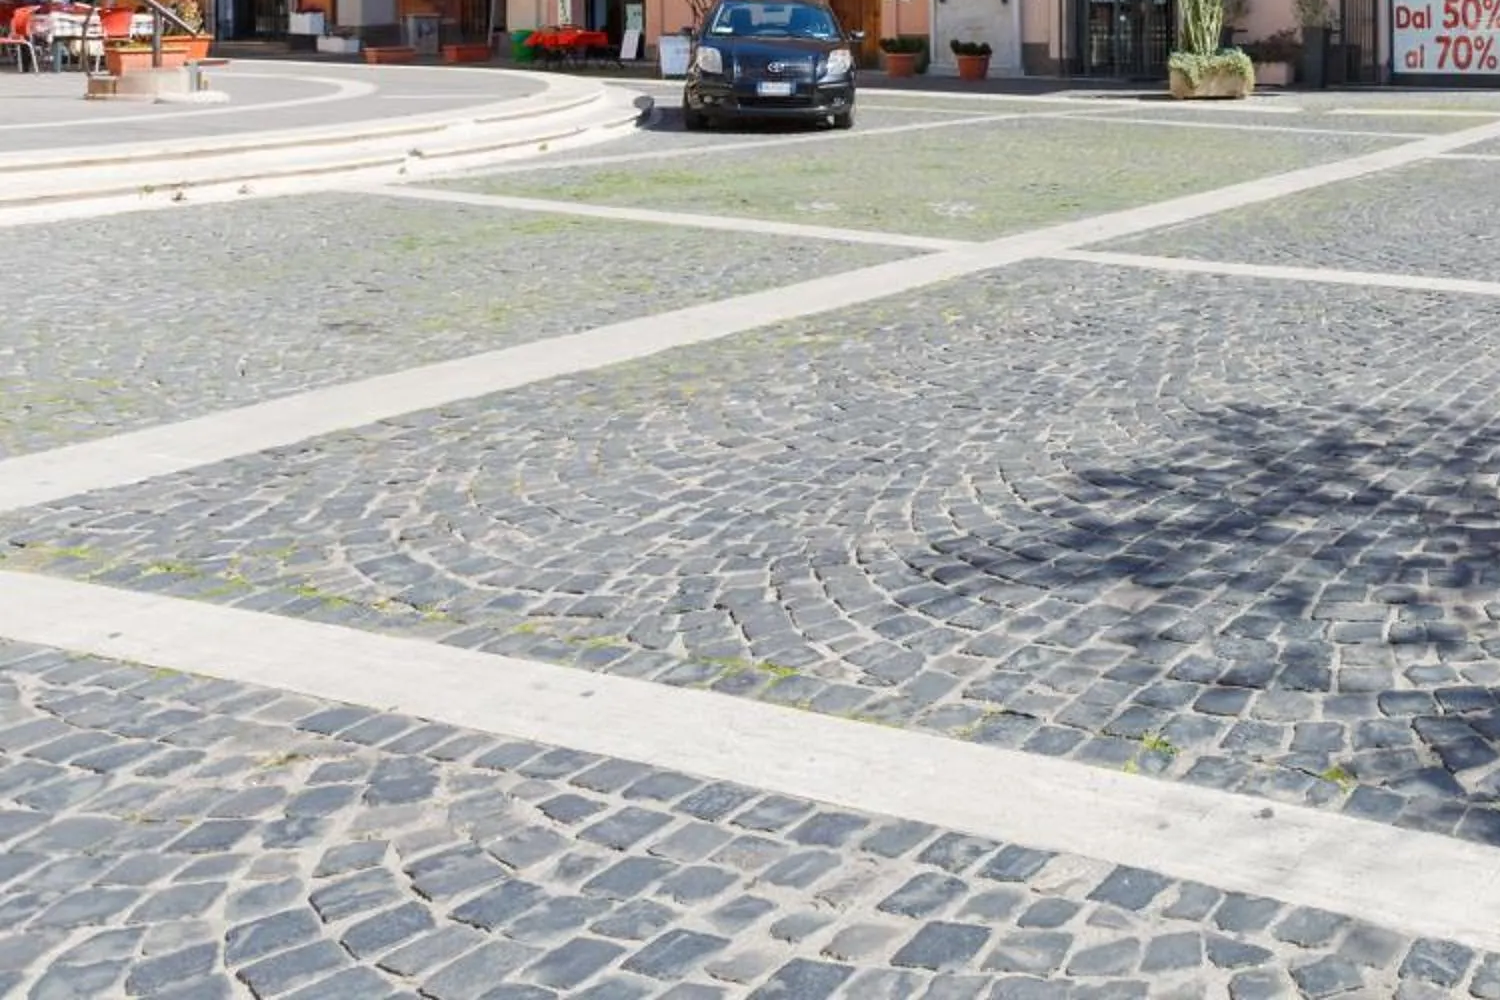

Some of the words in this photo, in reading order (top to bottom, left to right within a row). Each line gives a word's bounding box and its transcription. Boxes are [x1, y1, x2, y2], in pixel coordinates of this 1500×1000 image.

[1396, 4, 1431, 29] Dal
[1405, 44, 1424, 69] al
[1435, 35, 1497, 70] 70%
